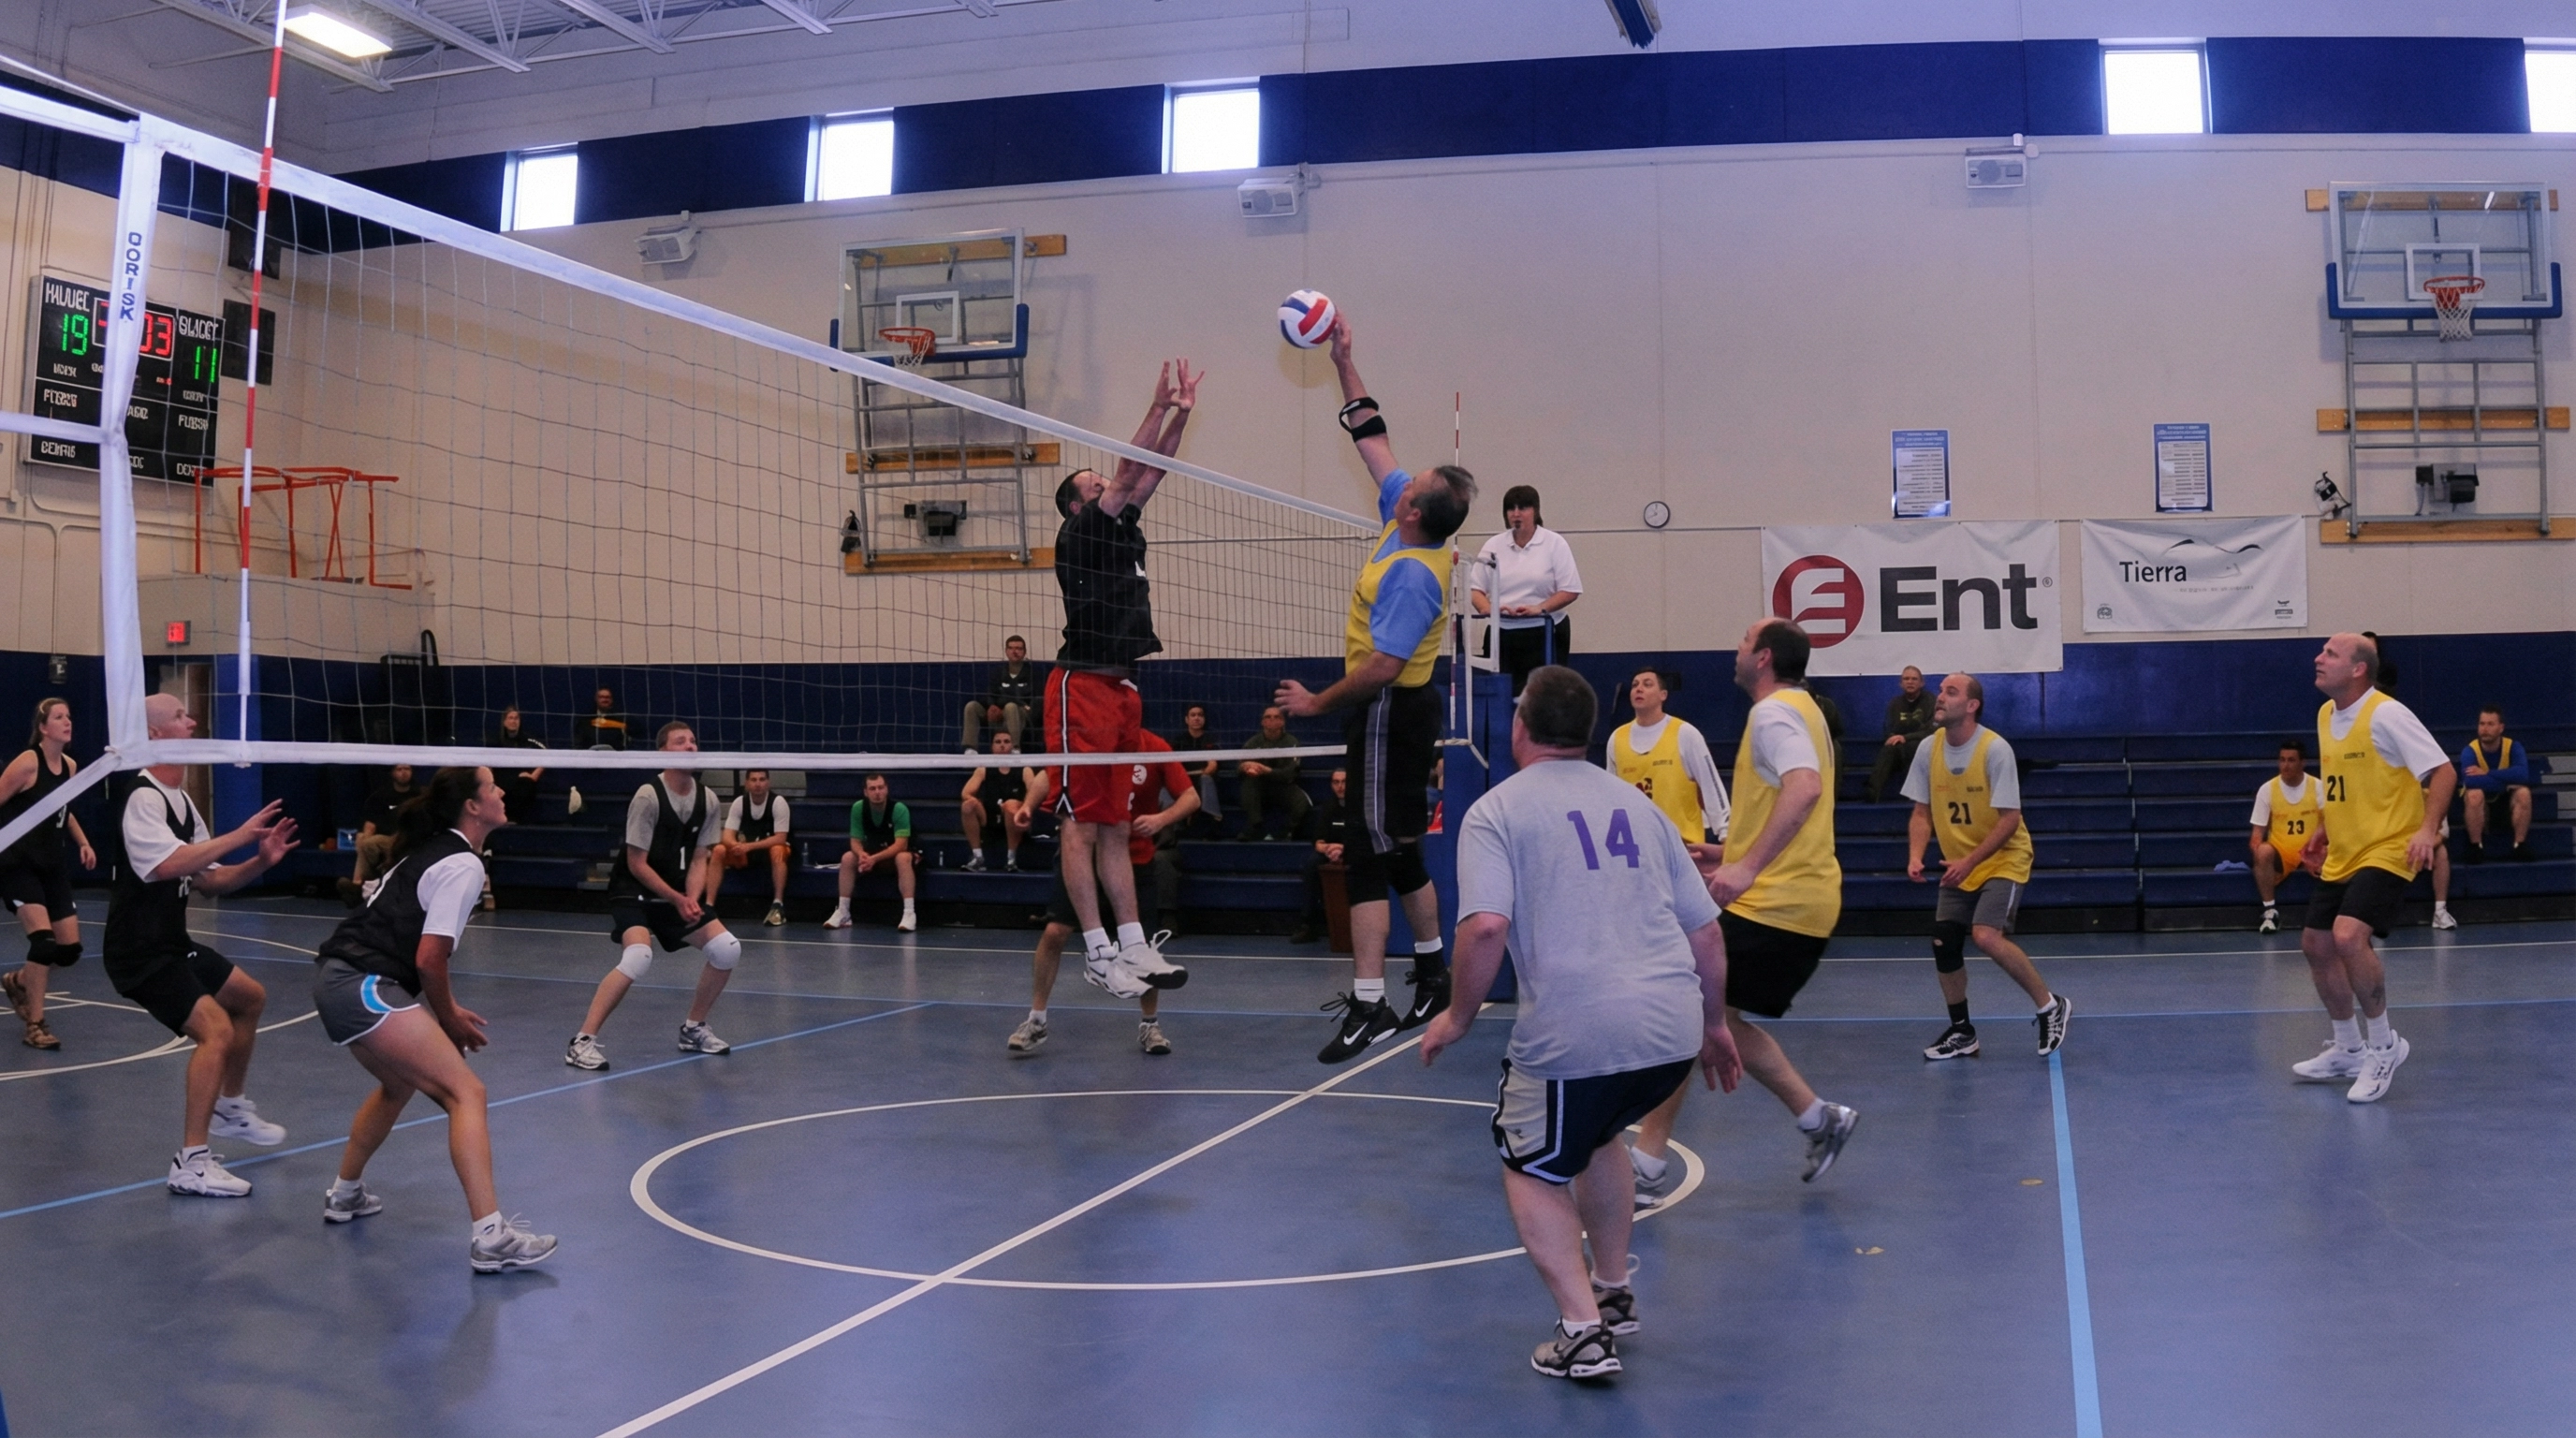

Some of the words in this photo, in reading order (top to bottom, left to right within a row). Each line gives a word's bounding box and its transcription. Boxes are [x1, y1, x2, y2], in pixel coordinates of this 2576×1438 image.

[62, 314, 89, 356] 19
[194, 345, 217, 383] 11
[2119, 560, 2188, 582] Tierra
[1880, 564, 2038, 633] Ent
[2326, 774, 2346, 802] 21
[1948, 801, 1972, 825] 21
[2287, 819, 2305, 835] 23
[1566, 808, 1641, 871] 14
